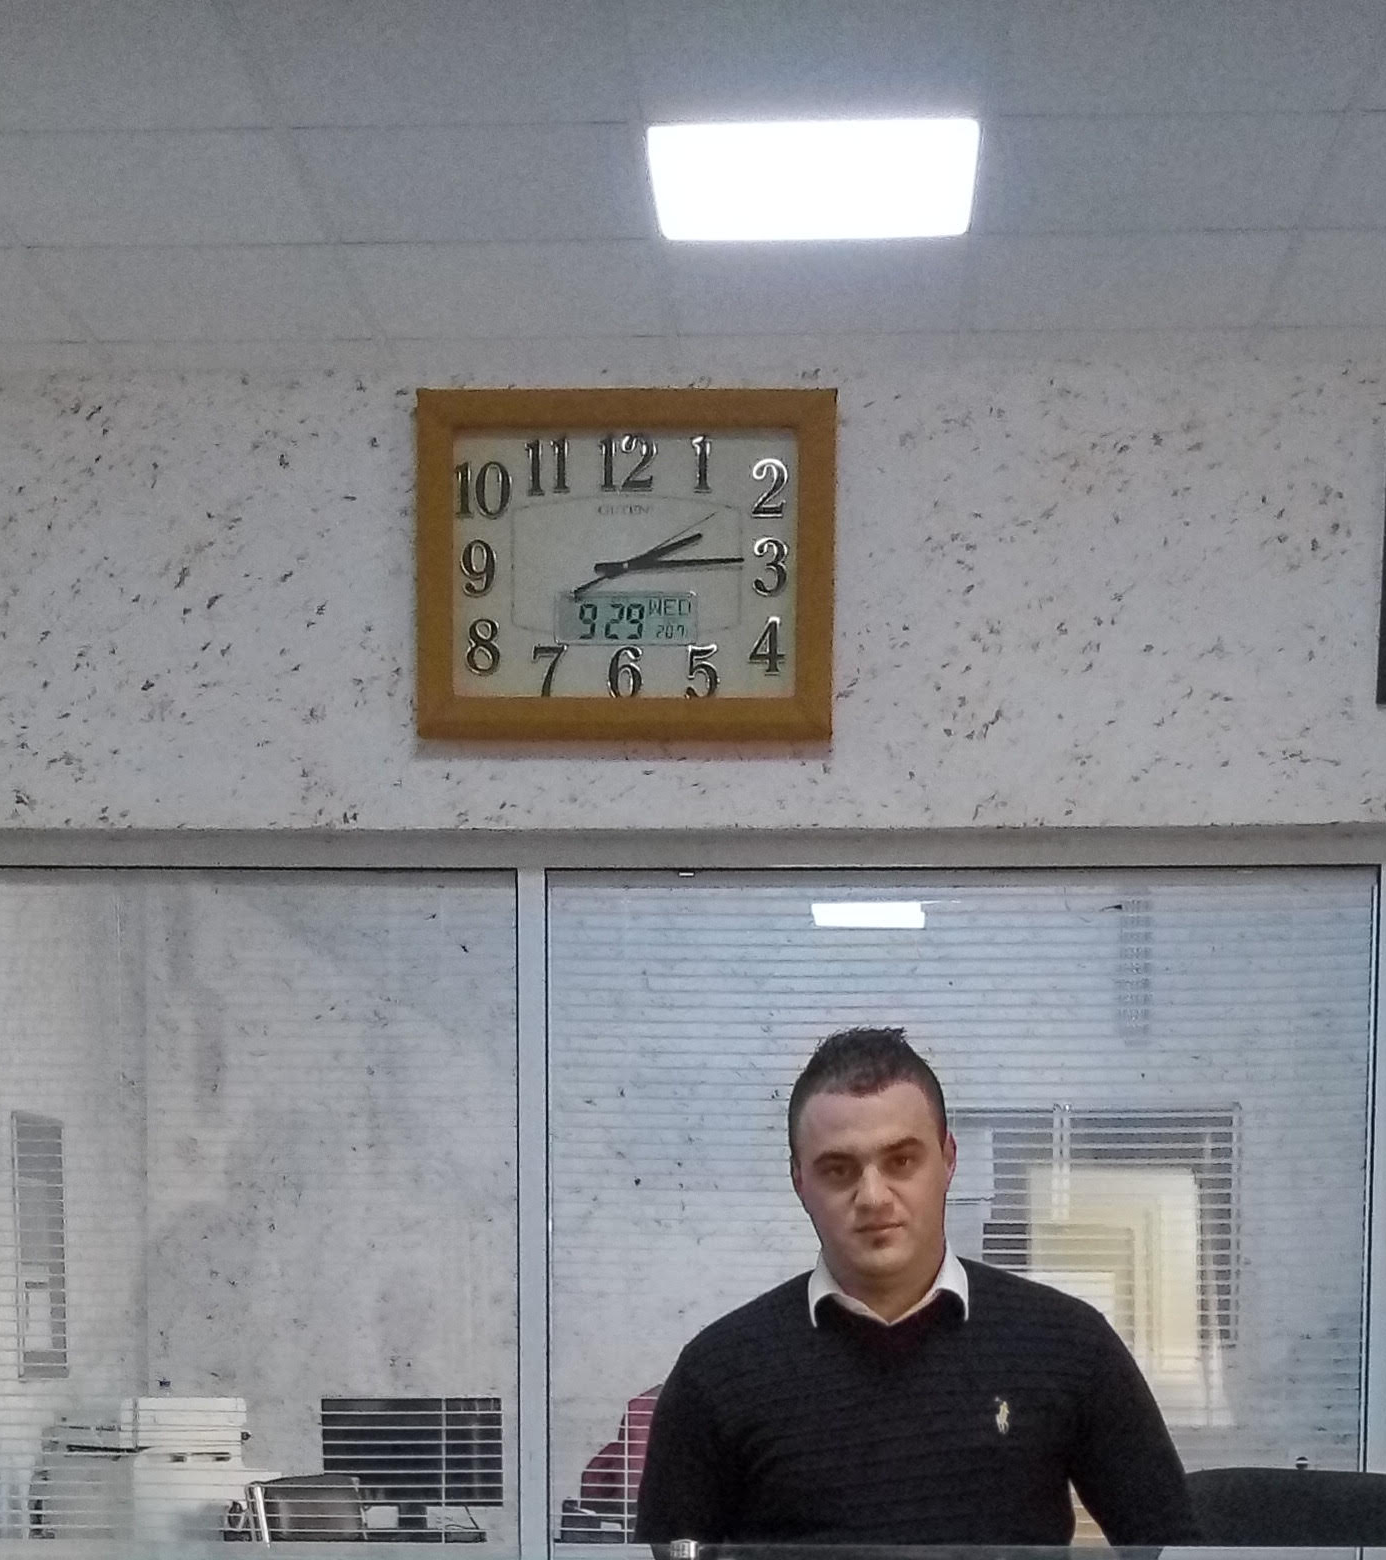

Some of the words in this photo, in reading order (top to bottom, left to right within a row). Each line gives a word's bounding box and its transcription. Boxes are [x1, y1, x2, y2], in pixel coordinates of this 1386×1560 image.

[453, 460, 512, 520] 10
[525, 436, 570, 496] 11
[598, 434, 658, 492] 12
[691, 435, 712, 494] 1
[752, 458, 789, 518] 2
[461, 539, 497, 597] 9
[752, 537, 789, 597] 3
[466, 619, 501, 676] 8
[532, 645, 568, 698] 7
[608, 646, 643, 699] 6
[685, 645, 720, 699] 5
[749, 616, 785, 676] 4
